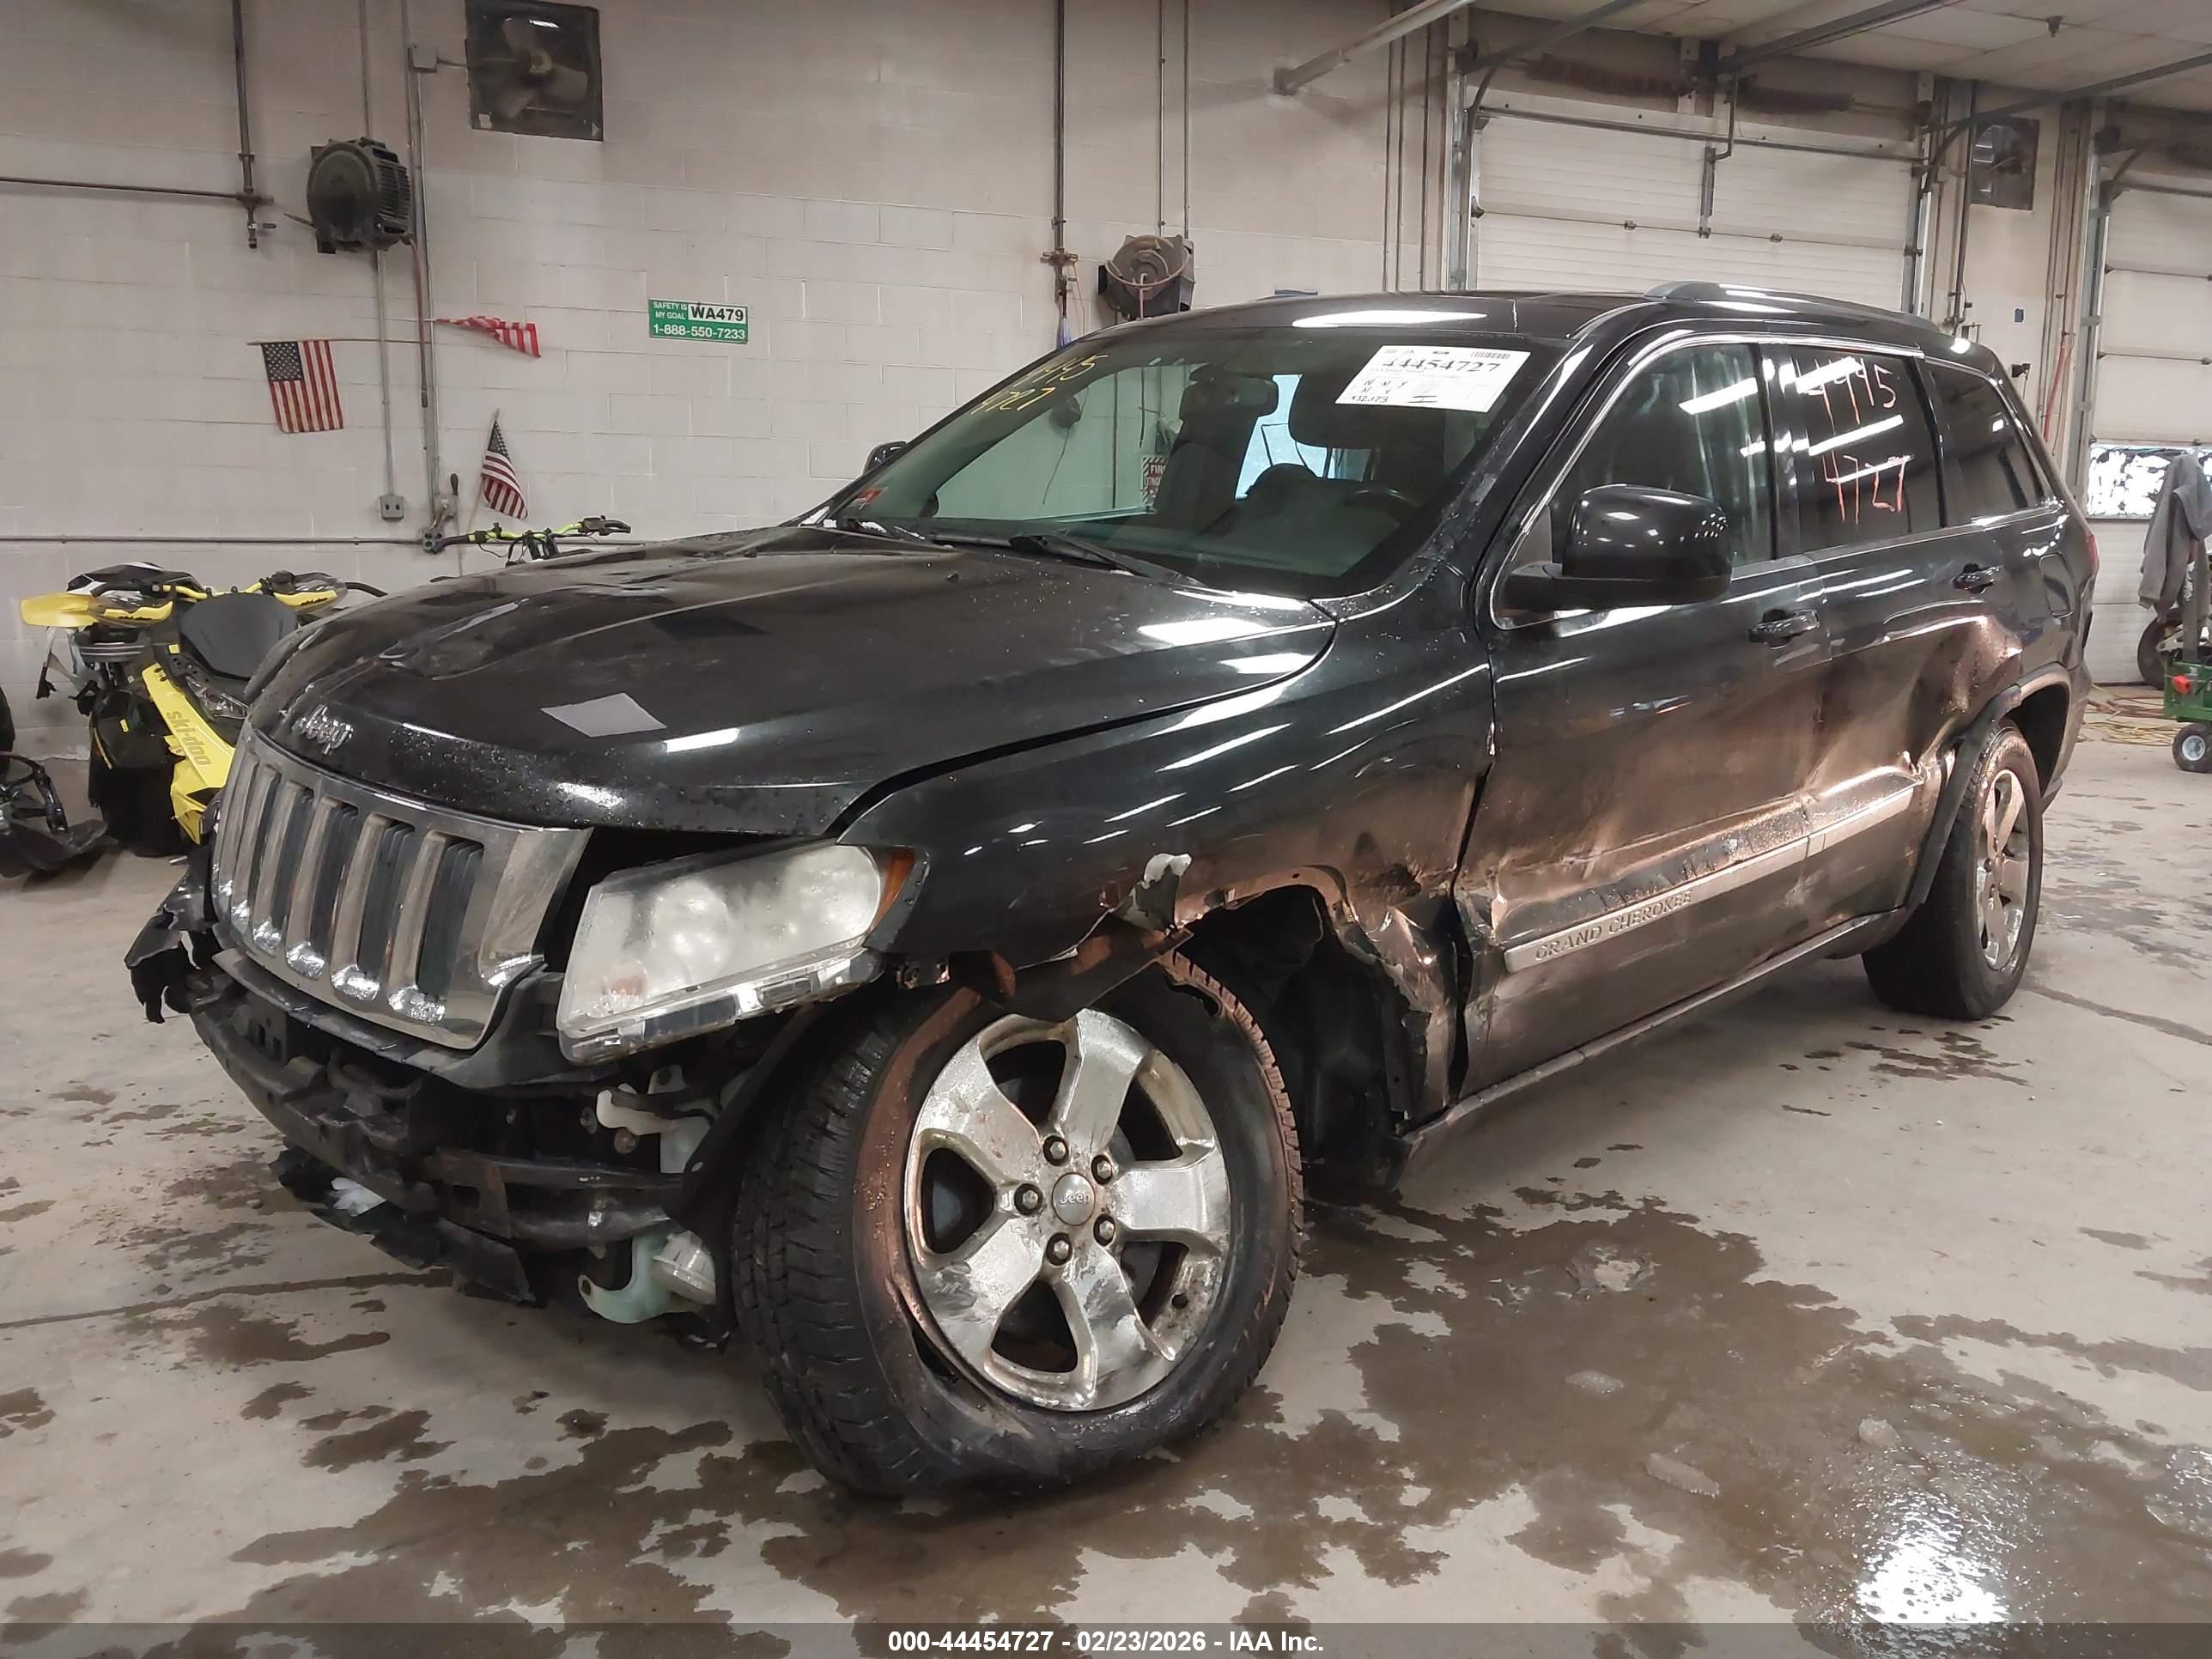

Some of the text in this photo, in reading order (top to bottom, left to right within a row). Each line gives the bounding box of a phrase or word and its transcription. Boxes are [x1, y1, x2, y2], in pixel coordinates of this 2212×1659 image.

[653, 301, 679, 310] SAFETY
[655, 311, 687, 320] MY GOAL
[690, 306, 744, 322] WA479
[653, 324, 745, 339] 1-888-550-7233
[1382, 358, 1501, 373] 44454727
[1534, 889, 1692, 962] GRAND CHEROKEE
